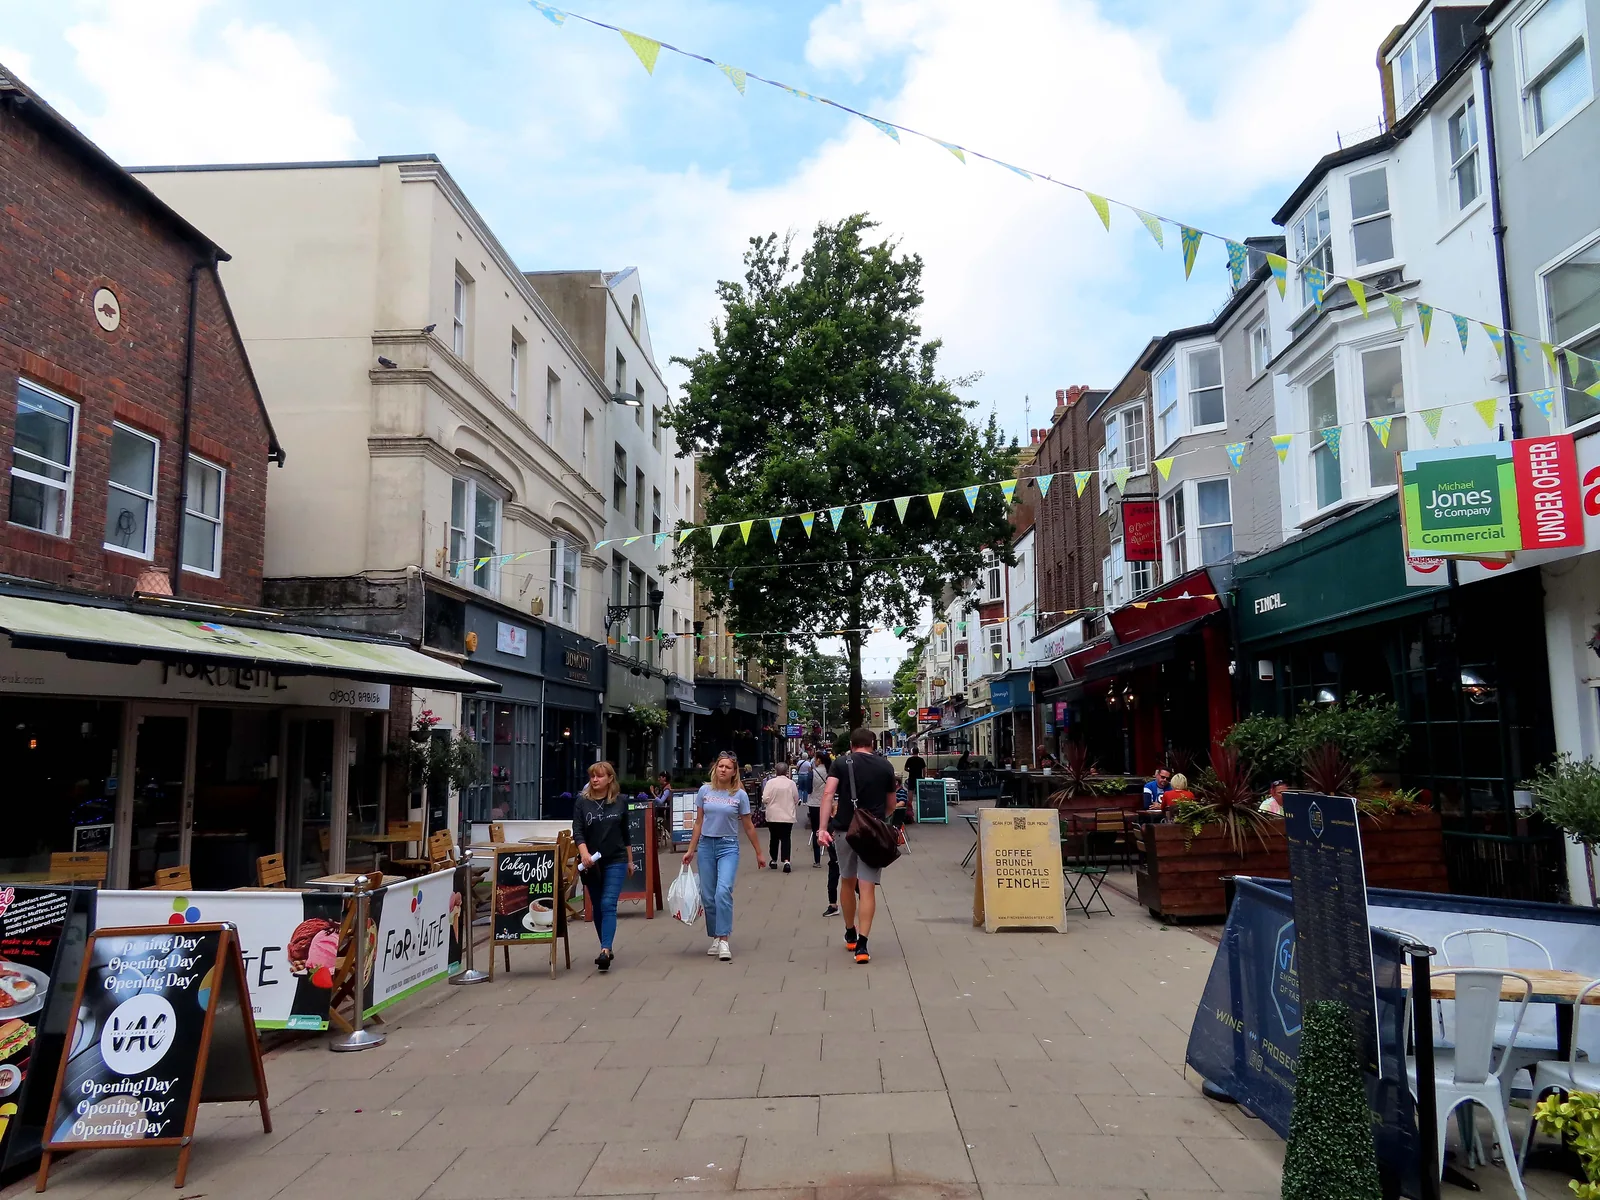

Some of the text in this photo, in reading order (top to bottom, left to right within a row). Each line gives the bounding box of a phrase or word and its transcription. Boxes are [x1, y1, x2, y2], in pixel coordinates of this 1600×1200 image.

[1438, 480, 1474, 492] Michael
[1529, 441, 1567, 542] UNDER OFFER
[1426, 489, 1492, 510] Jones
[1434, 507, 1491, 518] & Company
[1422, 527, 1505, 544] Commercial
[329, 688, 355, 705] 01903
[995, 849, 1032, 857] COFFEE
[500, 856, 525, 872] Cake
[996, 859, 1033, 867] BRUNCH
[996, 868, 1050, 877] COCKTAILS
[529, 882, 553, 894] £4.95
[11, 897, 39, 909] Breakfast
[37, 896, 67, 908] Homemade
[50, 902, 68, 911] Lunch
[5, 927, 25, 937] freshly
[26, 920, 51, 932] prepared
[6, 922, 22, 930] meals
[23, 918, 33, 926] and
[34, 915, 45, 923] lots
[45, 911, 60, 919] more
[174, 936, 205, 951] Day
[109, 954, 202, 975] Opening Day
[104, 973, 198, 993] Opening Day
[1279, 984, 1288, 994] OF
[1216, 1008, 1244, 1034] WINE
[113, 1013, 167, 1053] VAC
[81, 1076, 179, 1098] Opening Day
[77, 1097, 175, 1118] Opening Day
[72, 1118, 171, 1139] Opening Day
